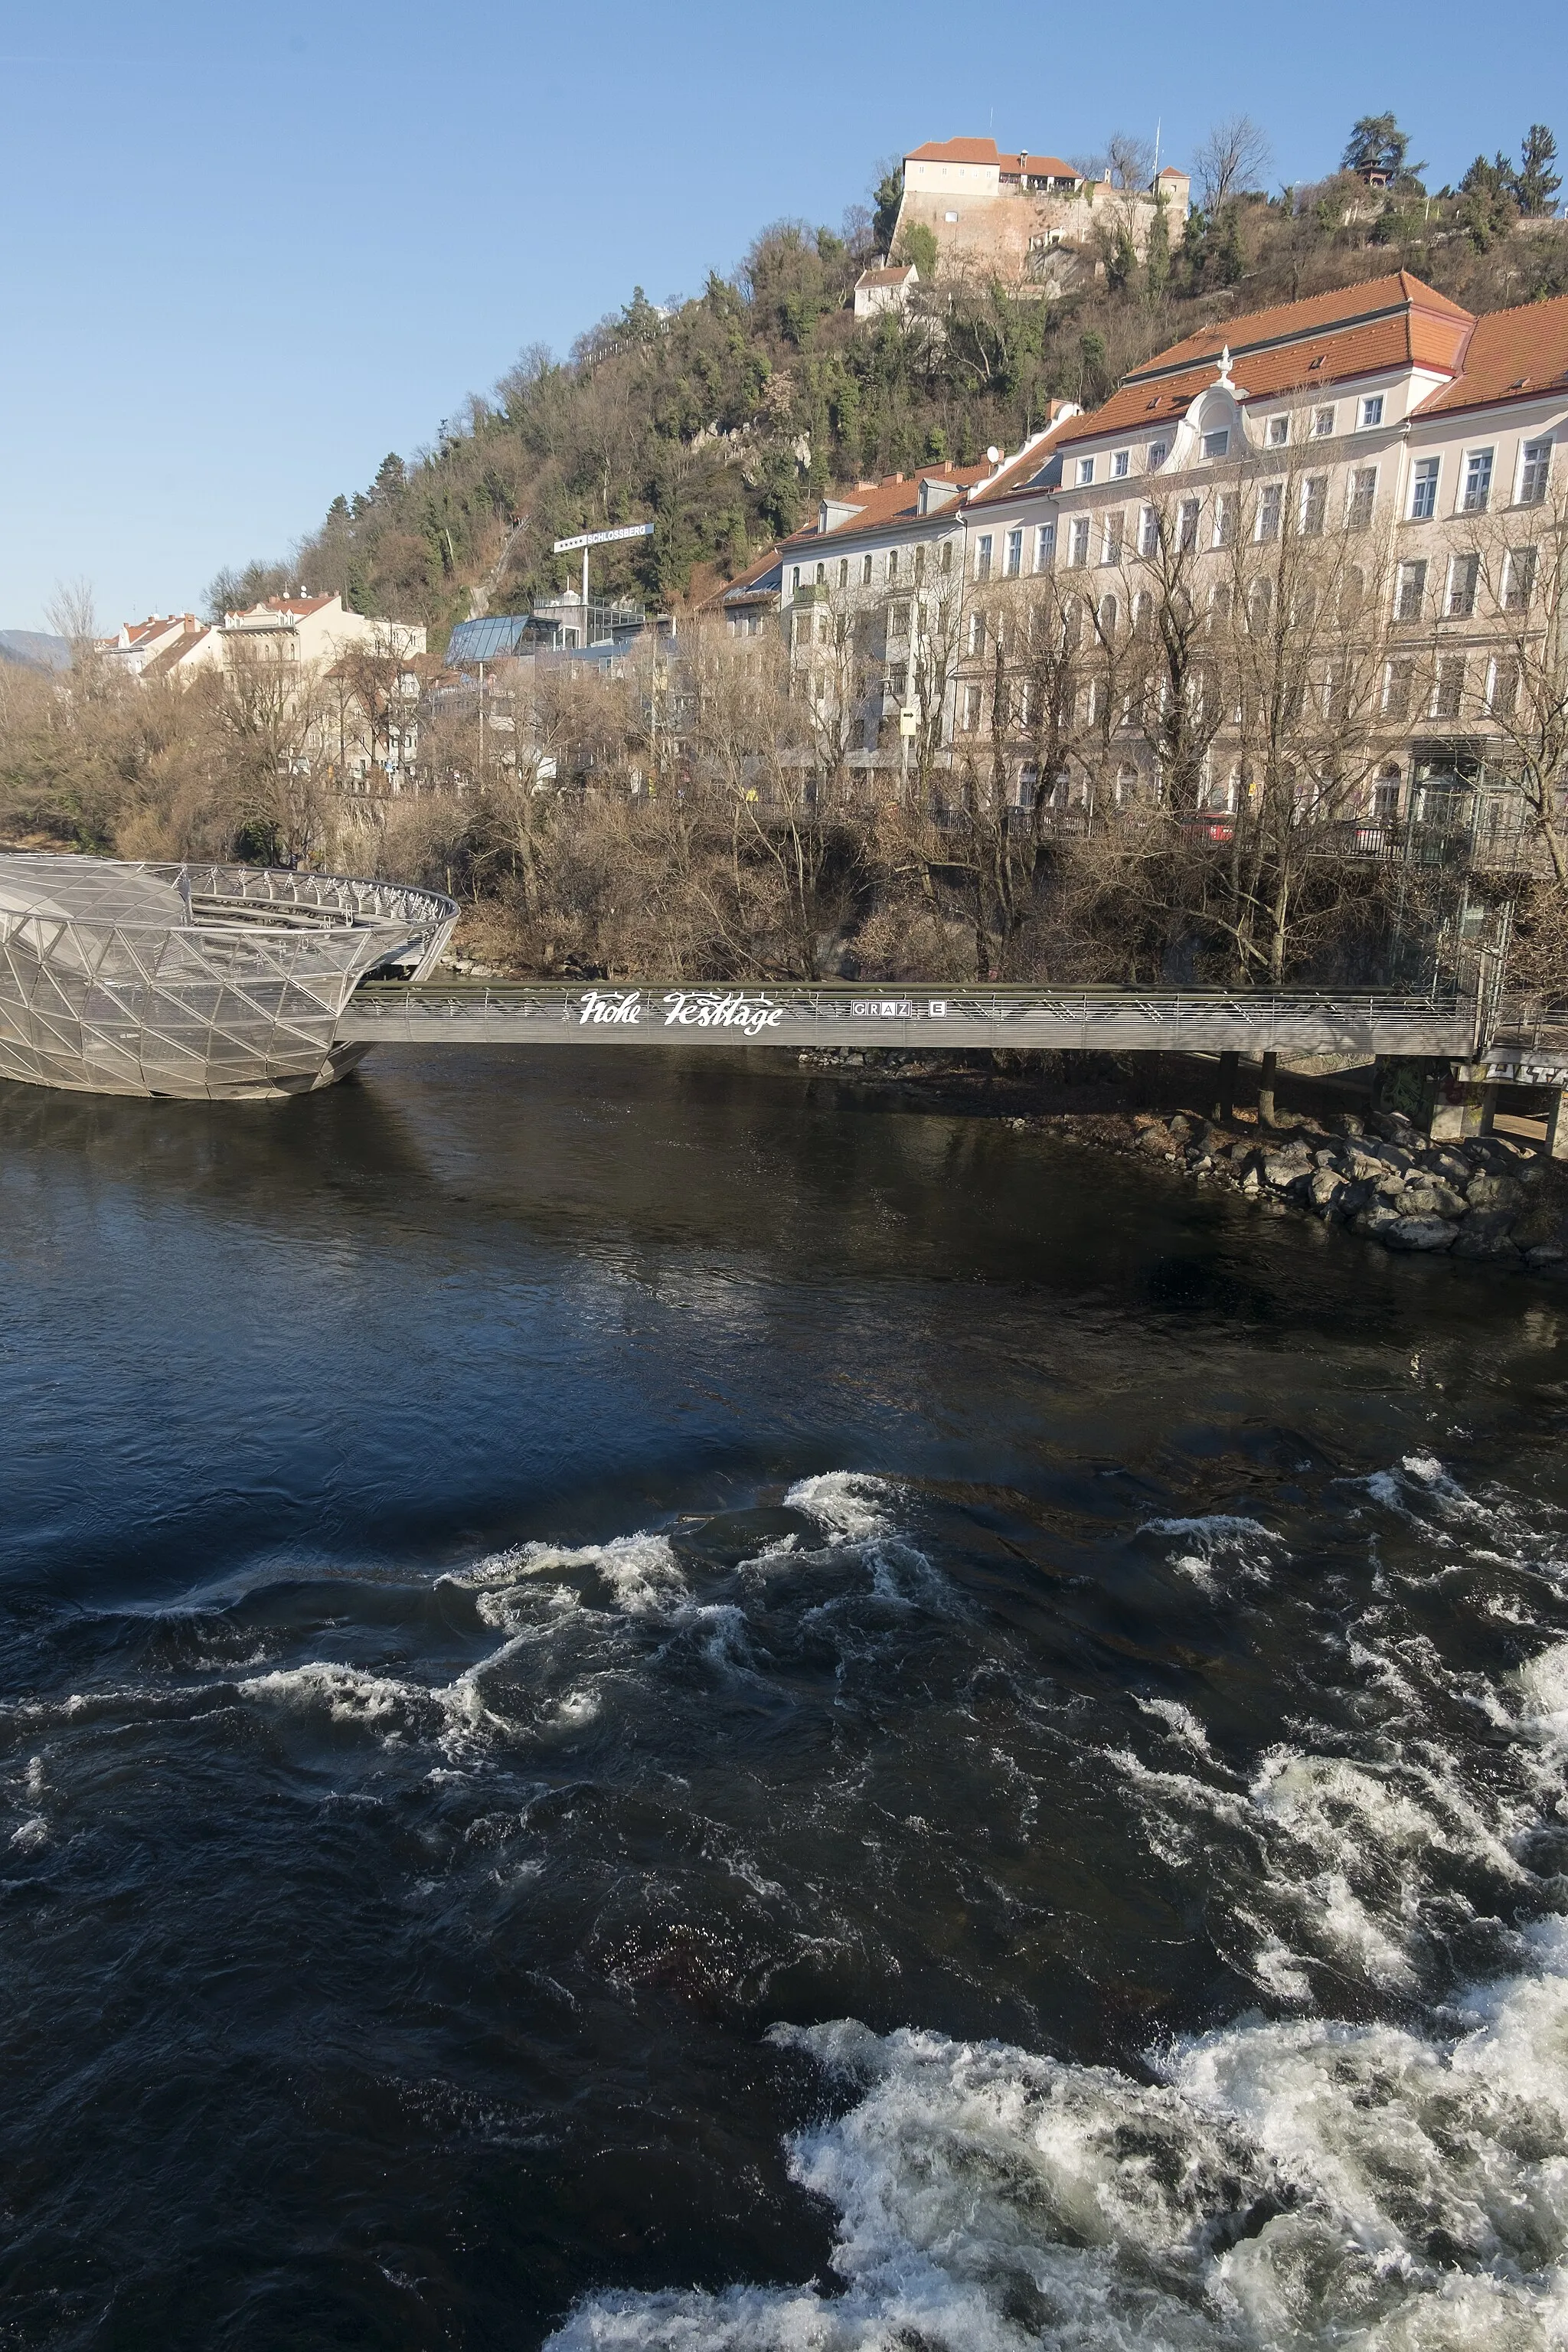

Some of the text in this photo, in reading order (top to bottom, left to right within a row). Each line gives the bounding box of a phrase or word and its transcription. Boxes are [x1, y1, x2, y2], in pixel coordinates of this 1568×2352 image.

[586, 525, 645, 544] SCHLOSSBERG
[580, 991, 783, 1036] Frohe Festtage
[854, 1003, 908, 1015] GRAZ
